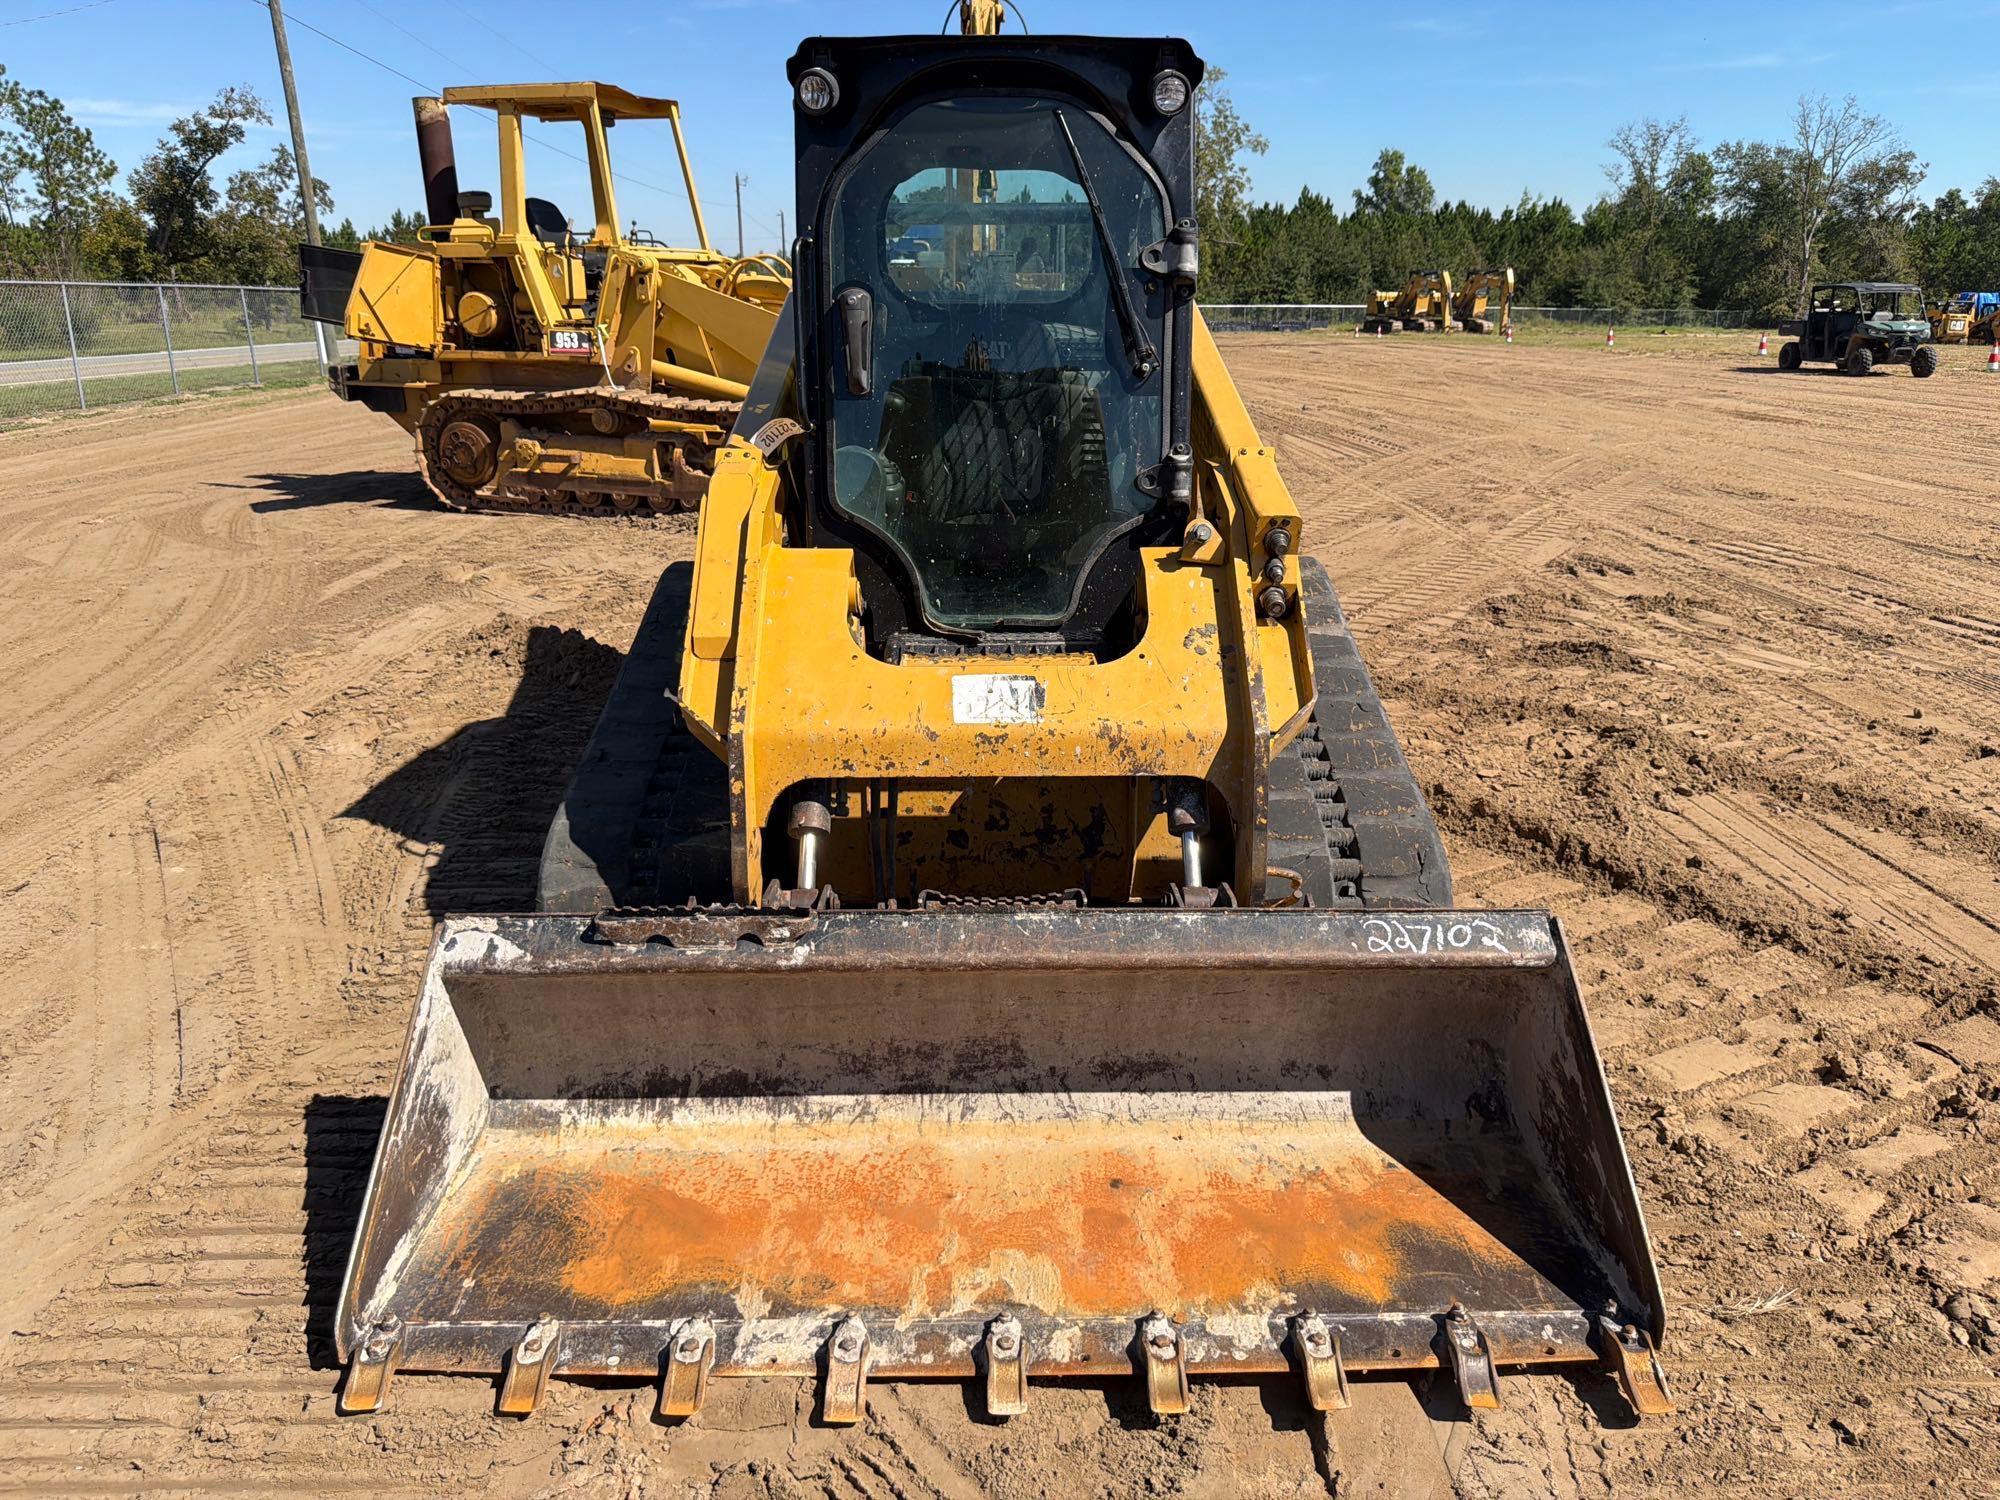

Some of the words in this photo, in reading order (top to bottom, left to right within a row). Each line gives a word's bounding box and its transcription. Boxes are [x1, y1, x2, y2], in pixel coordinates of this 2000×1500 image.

[1950, 320, 1966, 331] CAT
[555, 331, 579, 349] 953
[1363, 918, 1509, 955] 227102
